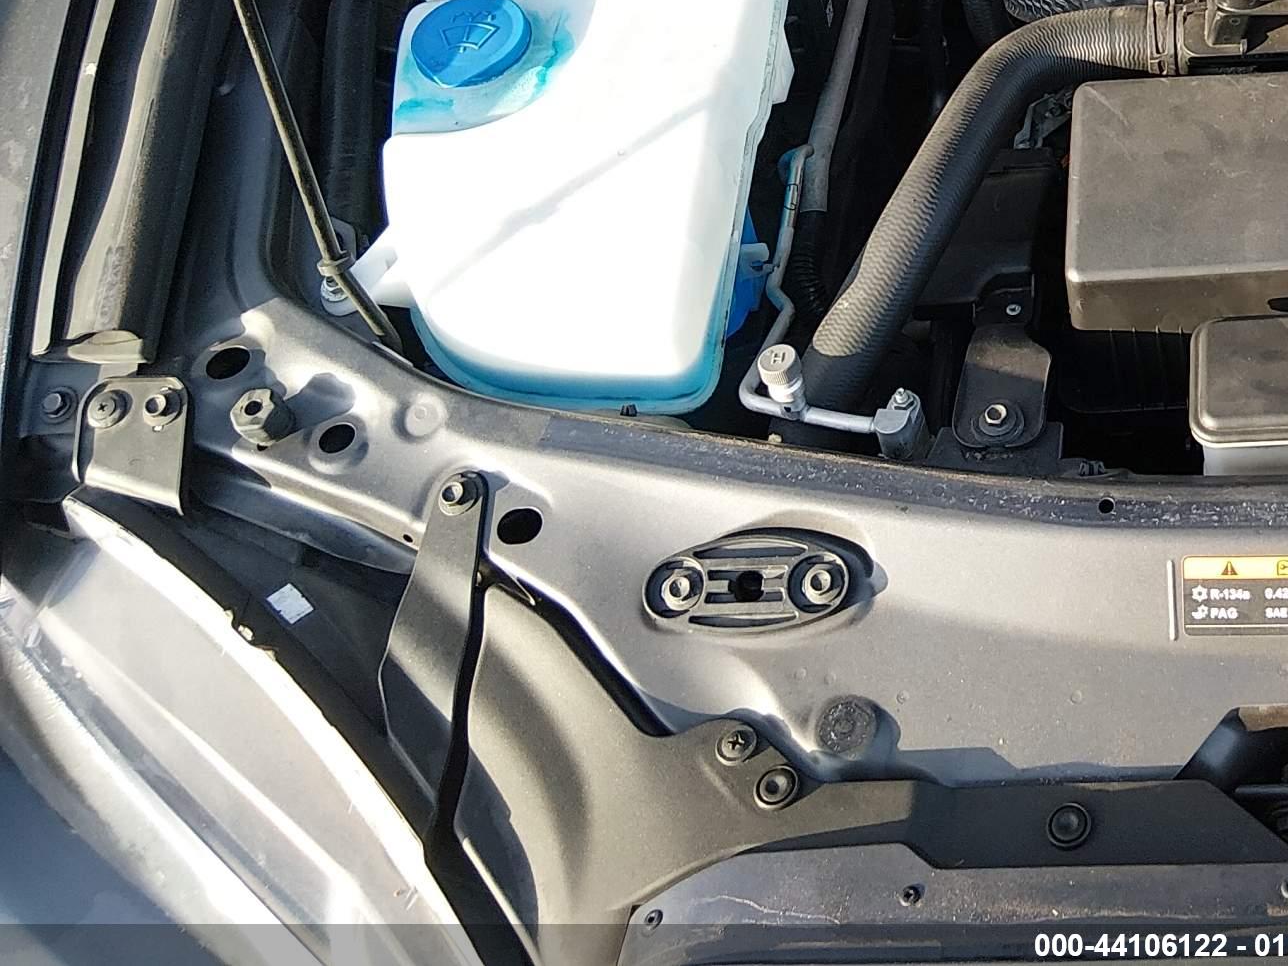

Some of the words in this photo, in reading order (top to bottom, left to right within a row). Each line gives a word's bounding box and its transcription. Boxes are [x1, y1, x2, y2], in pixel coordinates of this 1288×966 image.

[1209, 587, 1251, 600] R-134a
[1209, 607, 1239, 620] PAG
[1265, 607, 1288, 620] SAE
